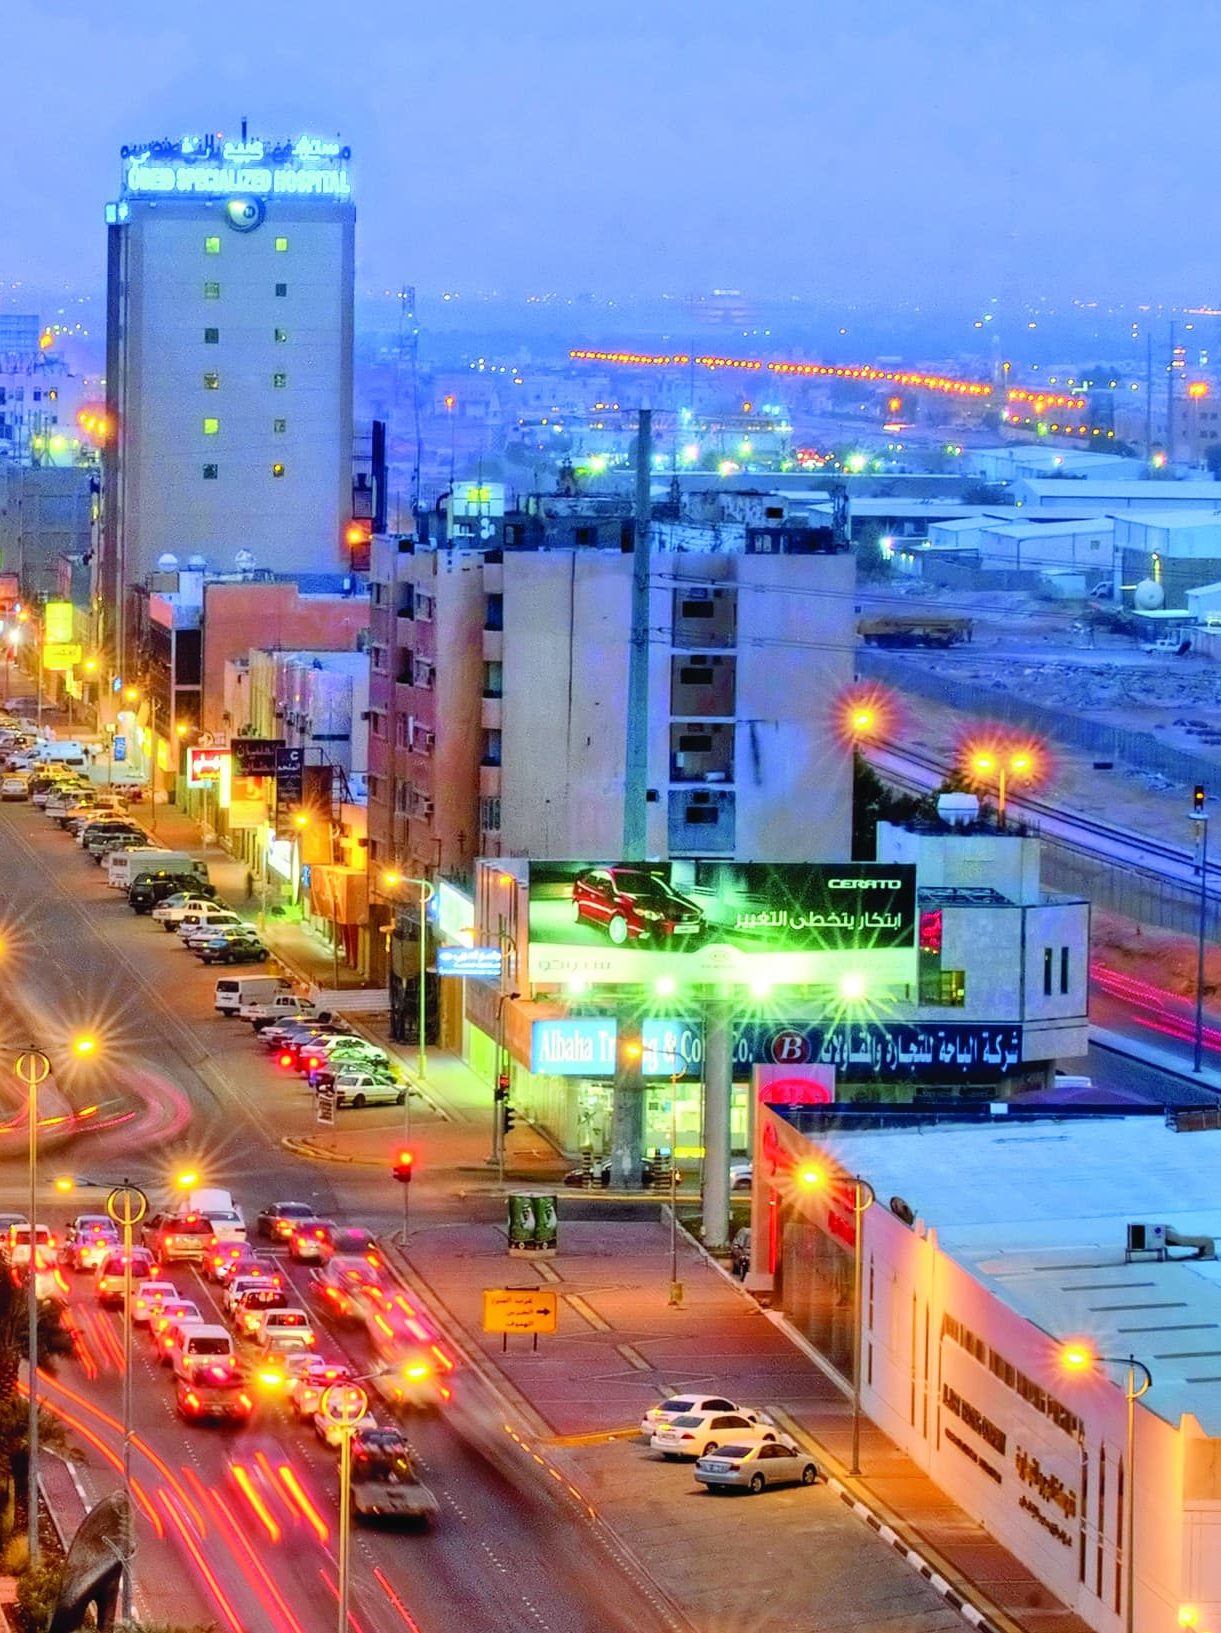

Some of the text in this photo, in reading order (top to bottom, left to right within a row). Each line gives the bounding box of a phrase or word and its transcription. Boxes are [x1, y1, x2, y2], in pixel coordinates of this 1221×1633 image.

[177, 168, 271, 192] SPECIALIZED
[274, 169, 351, 193] HOSPITAL
[828, 879, 902, 889] CERATO
[735, 910, 787, 930] التغيير
[790, 911, 854, 930] يتخطى
[858, 911, 902, 931] ابتكار
[540, 1030, 593, 1063] Albaha
[664, 1031, 677, 1063] &
[885, 1032, 934, 1072] للتجارة
[939, 1031, 978, 1072] الباحة
[983, 1031, 1019, 1072] شركة
